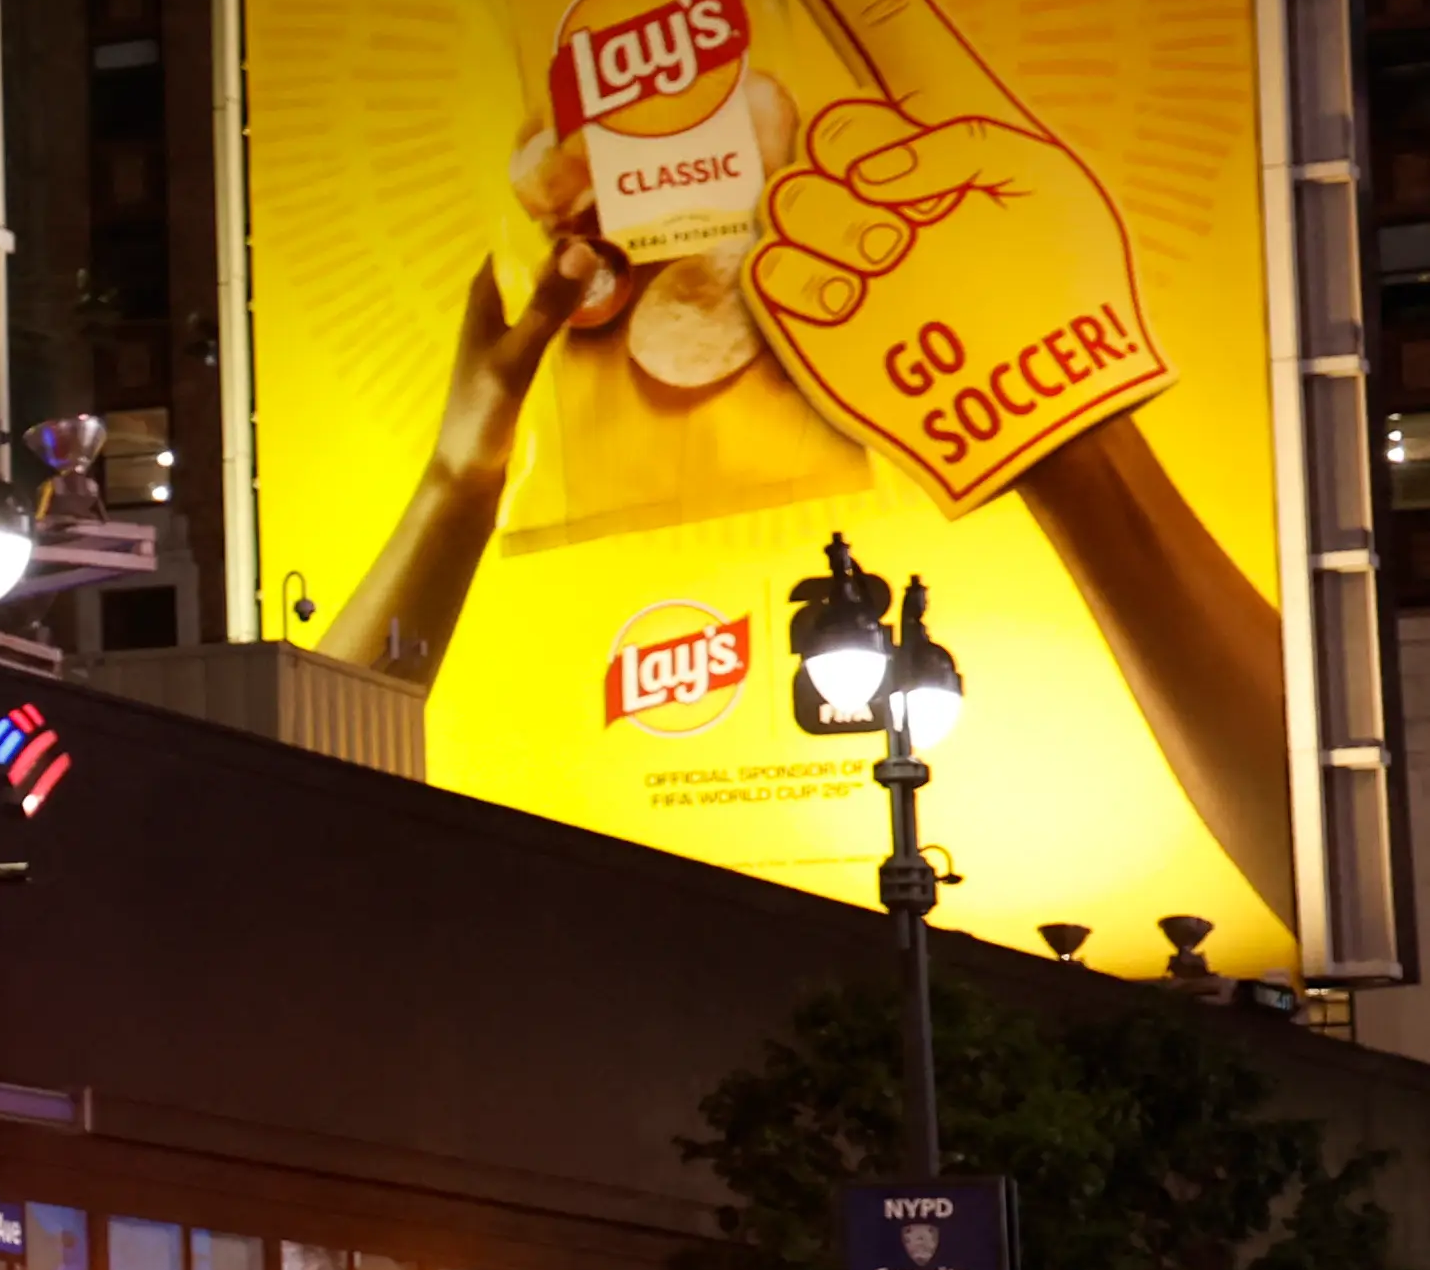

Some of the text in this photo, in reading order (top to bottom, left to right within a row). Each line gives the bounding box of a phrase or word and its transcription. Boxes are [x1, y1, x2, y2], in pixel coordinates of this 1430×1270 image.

[617, 153, 741, 196] CLASSIC
[885, 320, 967, 398] GO
[923, 303, 1139, 464] SOCCER!
[621, 627, 739, 712] Lay's
[644, 759, 866, 788] OFFICIAL SPONSOR OF
[650, 792, 693, 810] FIFA
[697, 786, 771, 807] WORLD
[776, 784, 817, 801] CUP
[884, 1198, 953, 1219] NYPD
